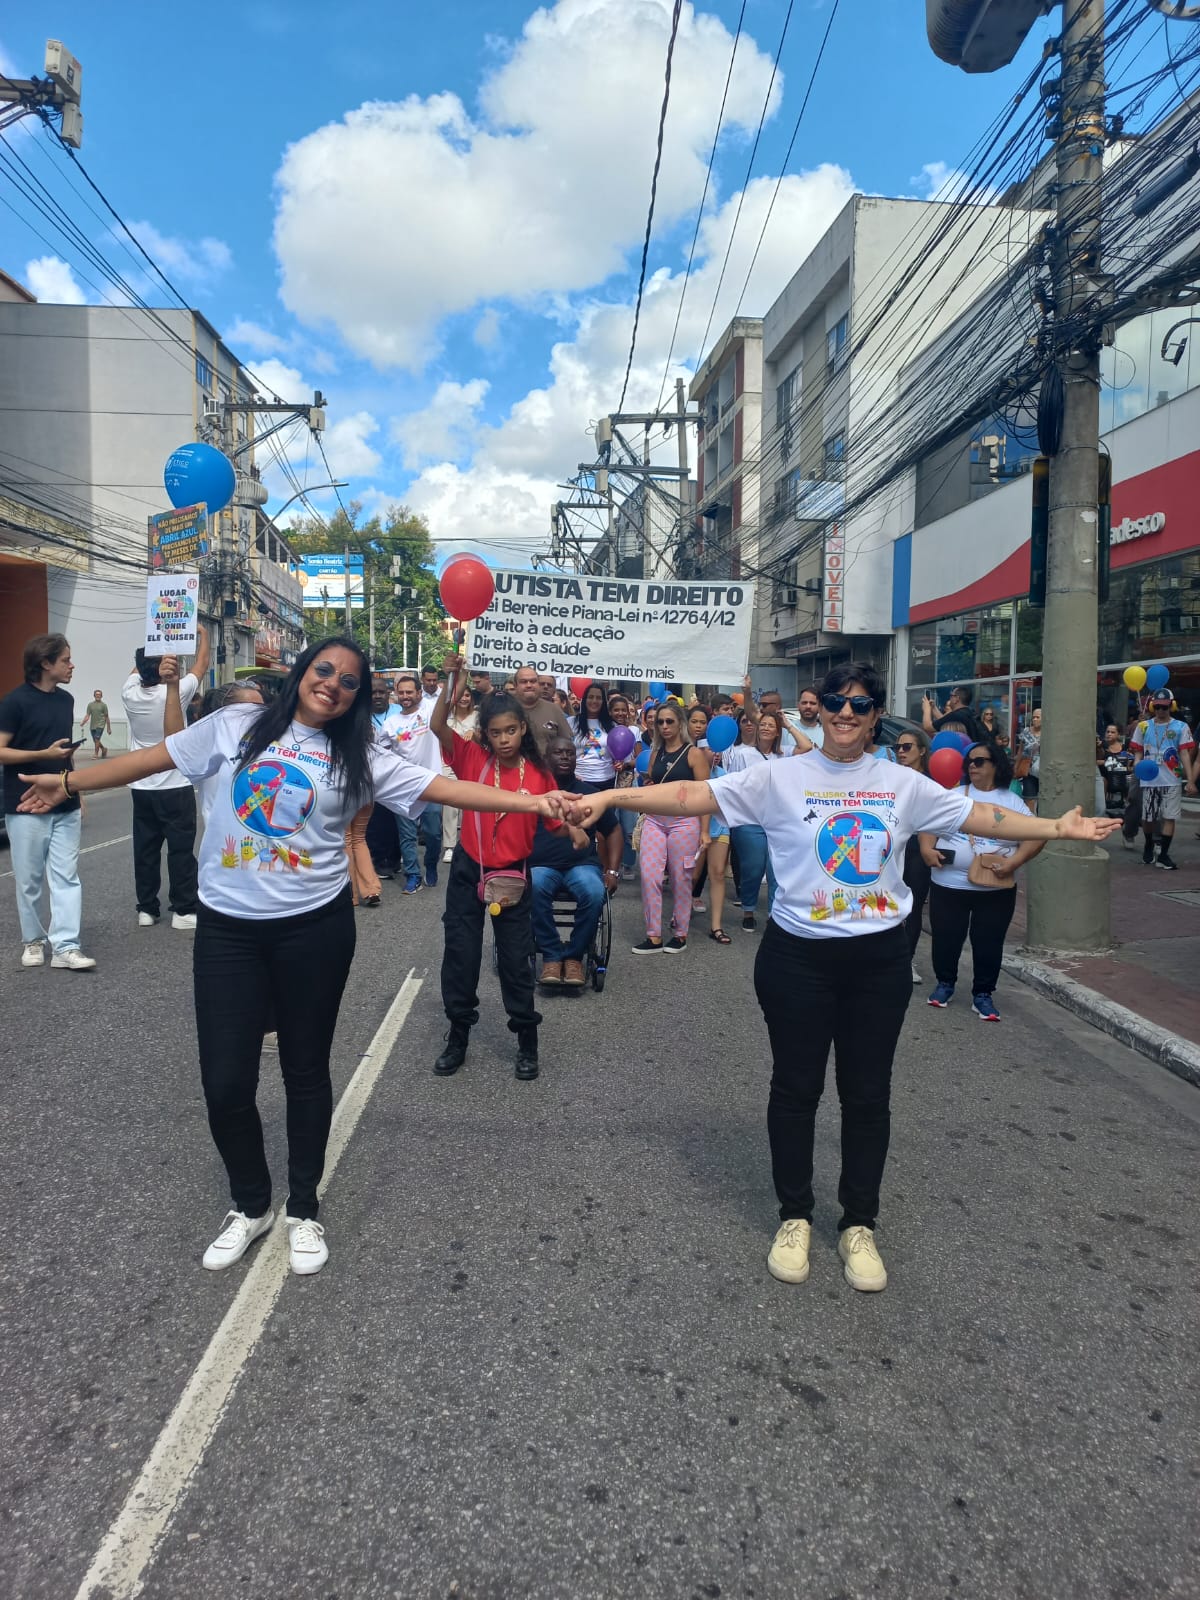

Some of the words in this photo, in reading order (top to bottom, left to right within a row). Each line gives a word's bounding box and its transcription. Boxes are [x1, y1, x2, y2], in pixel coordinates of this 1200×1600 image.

[160, 532, 180, 545] ABRIL
[181, 527, 198, 539] AZUL
[171, 545, 189, 556] MESES
[160, 589, 187, 597] LUGAR
[494, 573, 583, 600] UTISTA
[586, 580, 640, 603] TEM
[646, 585, 744, 606] DIREITO
[486, 597, 499, 612] ei
[501, 598, 570, 617] Berenice
[164, 622, 187, 630] ONDE
[475, 616, 524, 633] Direito
[527, 618, 538, 635] à
[541, 622, 625, 642] educação
[164, 633, 195, 642] QUISER
[473, 634, 523, 651] Direito
[526, 638, 537, 653] à
[540, 641, 591, 656] saúde
[472, 653, 523, 669] Direito
[551, 658, 593, 675] lazer
[595, 666, 605, 675] e
[607, 663, 643, 678] muito
[645, 665, 675, 679] mais
[277, 747, 297, 759] TEM
[848, 790, 855, 798] E
[856, 790, 896, 800] RESPEITO
[806, 797, 841, 807] AUTISTA
[842, 799, 862, 807] TEM
